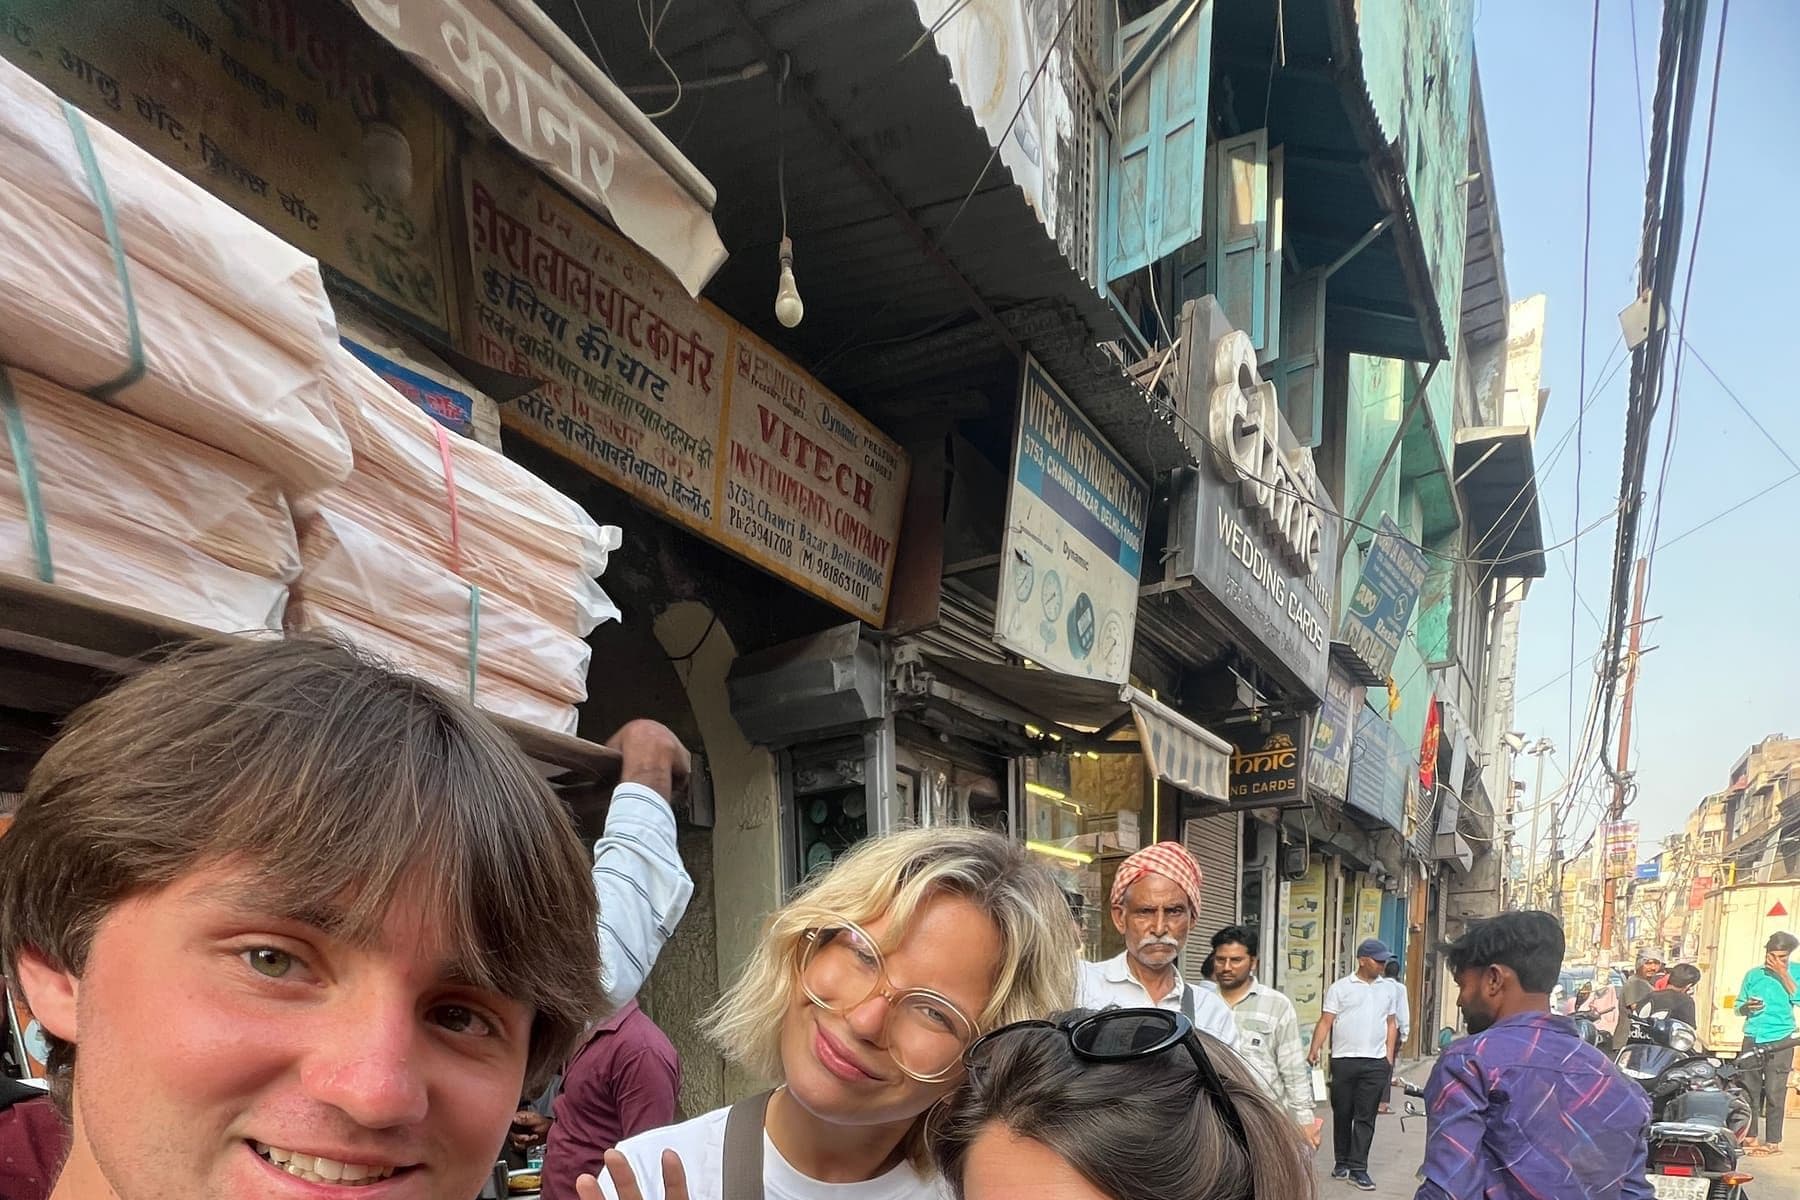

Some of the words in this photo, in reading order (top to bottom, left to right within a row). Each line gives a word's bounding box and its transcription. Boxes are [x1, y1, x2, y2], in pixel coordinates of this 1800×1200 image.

[615, 349, 671, 402] चाट
[821, 403, 859, 448] Dynamic
[1028, 377, 1068, 458] VITECH
[757, 403, 874, 512] VITECH
[1046, 455, 1076, 497] CHAWRI
[757, 499, 796, 537] Chawri
[834, 507, 891, 569] COMPANY
[1062, 540, 1089, 571] Dynamic
[1217, 504, 1287, 608] WEDDING
[1287, 591, 1324, 653] CARDS
[1252, 778, 1296, 795] CARDS
